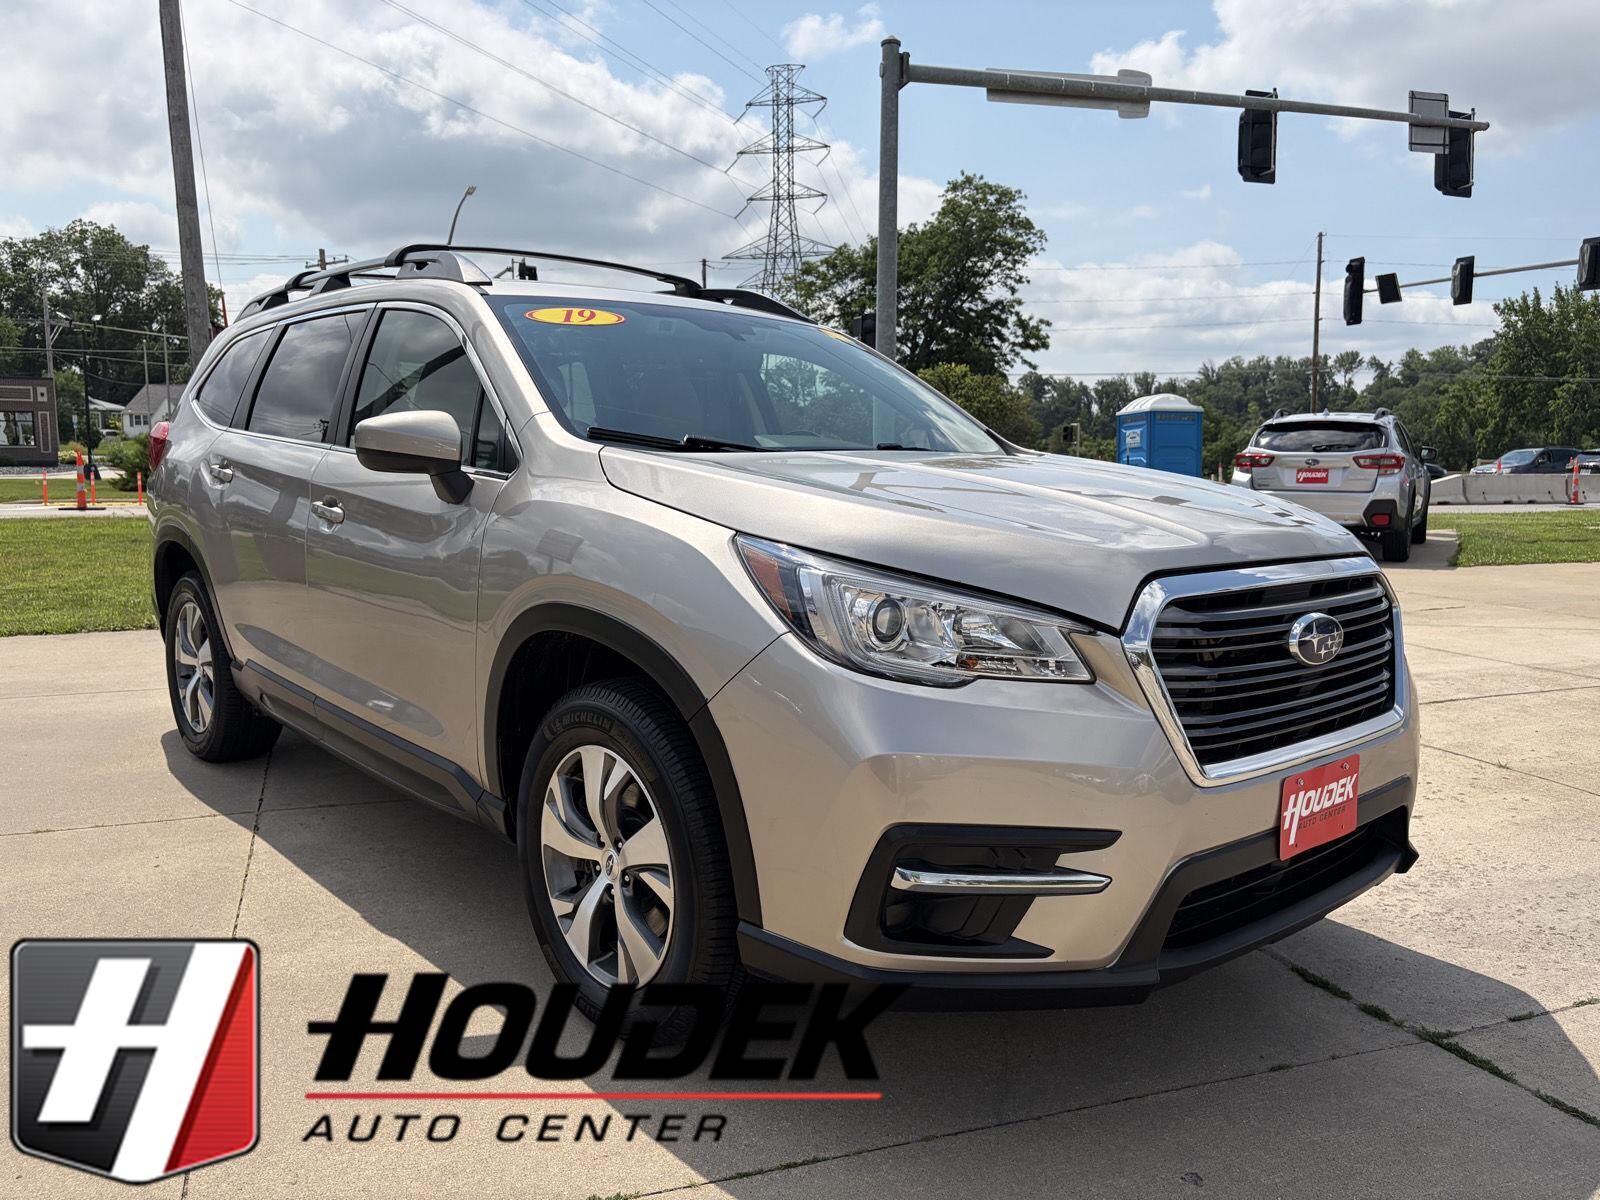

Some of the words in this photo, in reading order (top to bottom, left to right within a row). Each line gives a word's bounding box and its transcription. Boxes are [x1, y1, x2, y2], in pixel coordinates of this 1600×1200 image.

[562, 309, 597, 323] 19
[562, 711, 612, 730] MICHELIN
[1283, 773, 1358, 846] HOUDEK
[1297, 816, 1317, 829] AUTO
[1320, 805, 1346, 820] CENTER
